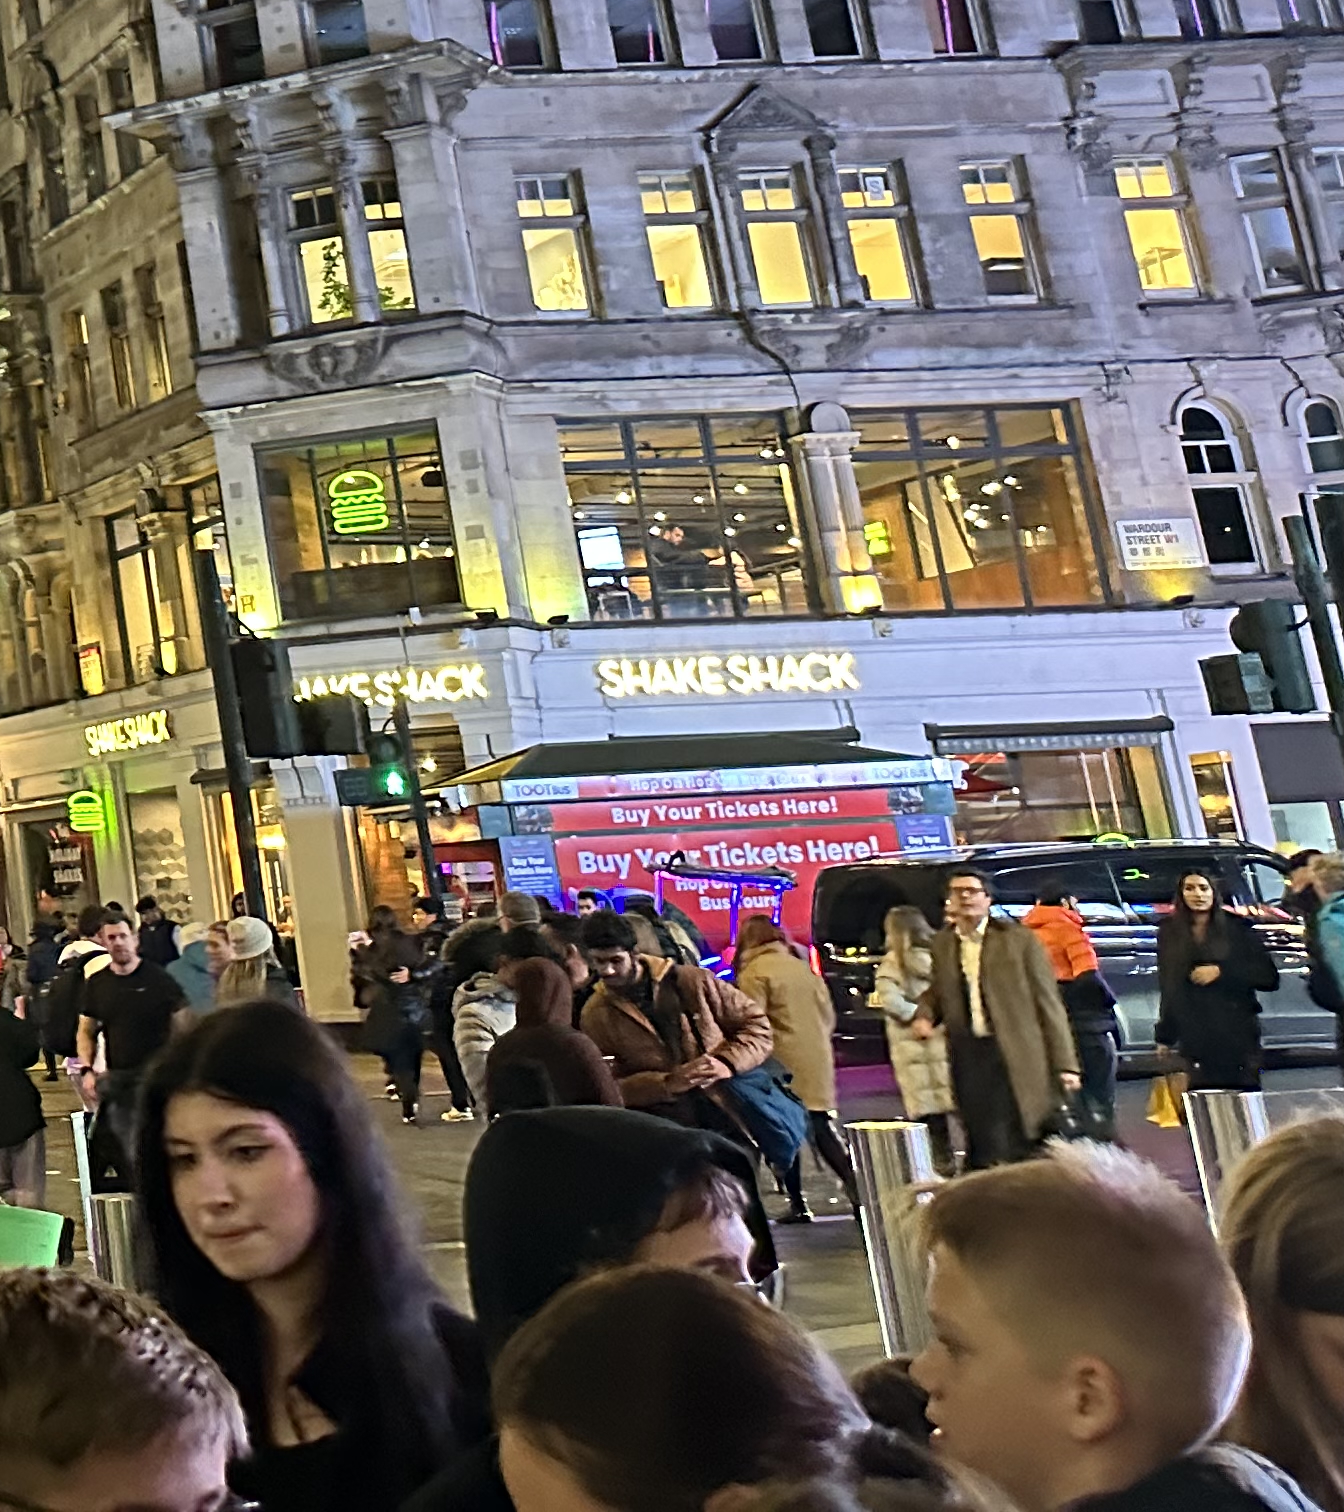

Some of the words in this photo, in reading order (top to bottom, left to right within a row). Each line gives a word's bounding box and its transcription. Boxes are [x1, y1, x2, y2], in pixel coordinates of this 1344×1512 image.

[1123, 523, 1172, 533] WARDOUR
[1125, 534, 1161, 545] STREET
[1163, 534, 1179, 543] W1
[374, 663, 488, 707] SHACK
[598, 655, 728, 698] SHAKE
[726, 651, 860, 696] SHACK
[85, 719, 128, 756] SHAKE
[126, 710, 171, 749] SHACK
[611, 806, 650, 827] Buy
[653, 804, 702, 821] Your
[705, 798, 780, 820] Tickets
[782, 796, 839, 814] Here!
[577, 850, 631, 879] Buy
[703, 839, 804, 868] Tickets
[805, 836, 879, 863] Here!
[699, 896, 731, 911] Bus
